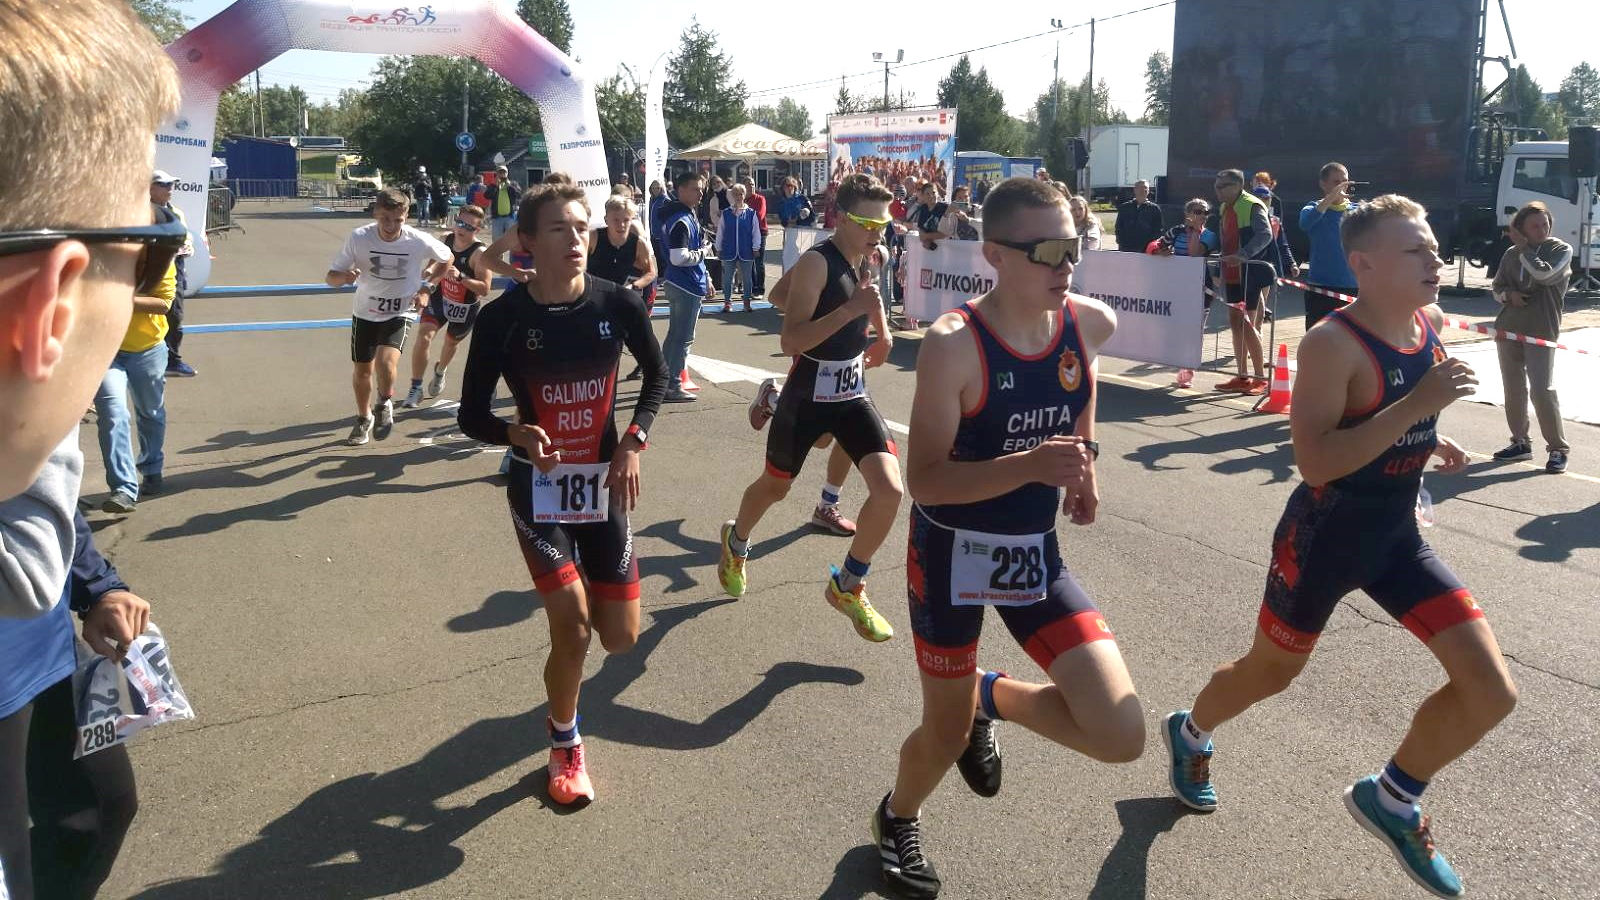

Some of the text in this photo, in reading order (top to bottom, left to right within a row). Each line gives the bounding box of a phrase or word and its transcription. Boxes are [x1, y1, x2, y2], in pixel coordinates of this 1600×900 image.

[155, 134, 207, 148] АЗПРОМБАНК
[174, 182, 203, 193] КОЙЛ
[933, 272, 993, 294] ЛУКОЙЛ
[378, 297, 402, 312] 219
[447, 303, 467, 319] 209
[833, 363, 859, 394] 195
[542, 377, 606, 405] GALIMOV
[558, 408, 593, 431] RUS
[1007, 404, 1072, 433] CHITA
[556, 473, 599, 511] 181
[535, 537, 564, 560] KRAY
[989, 545, 1044, 590] 228
[82, 721, 117, 752] 289
